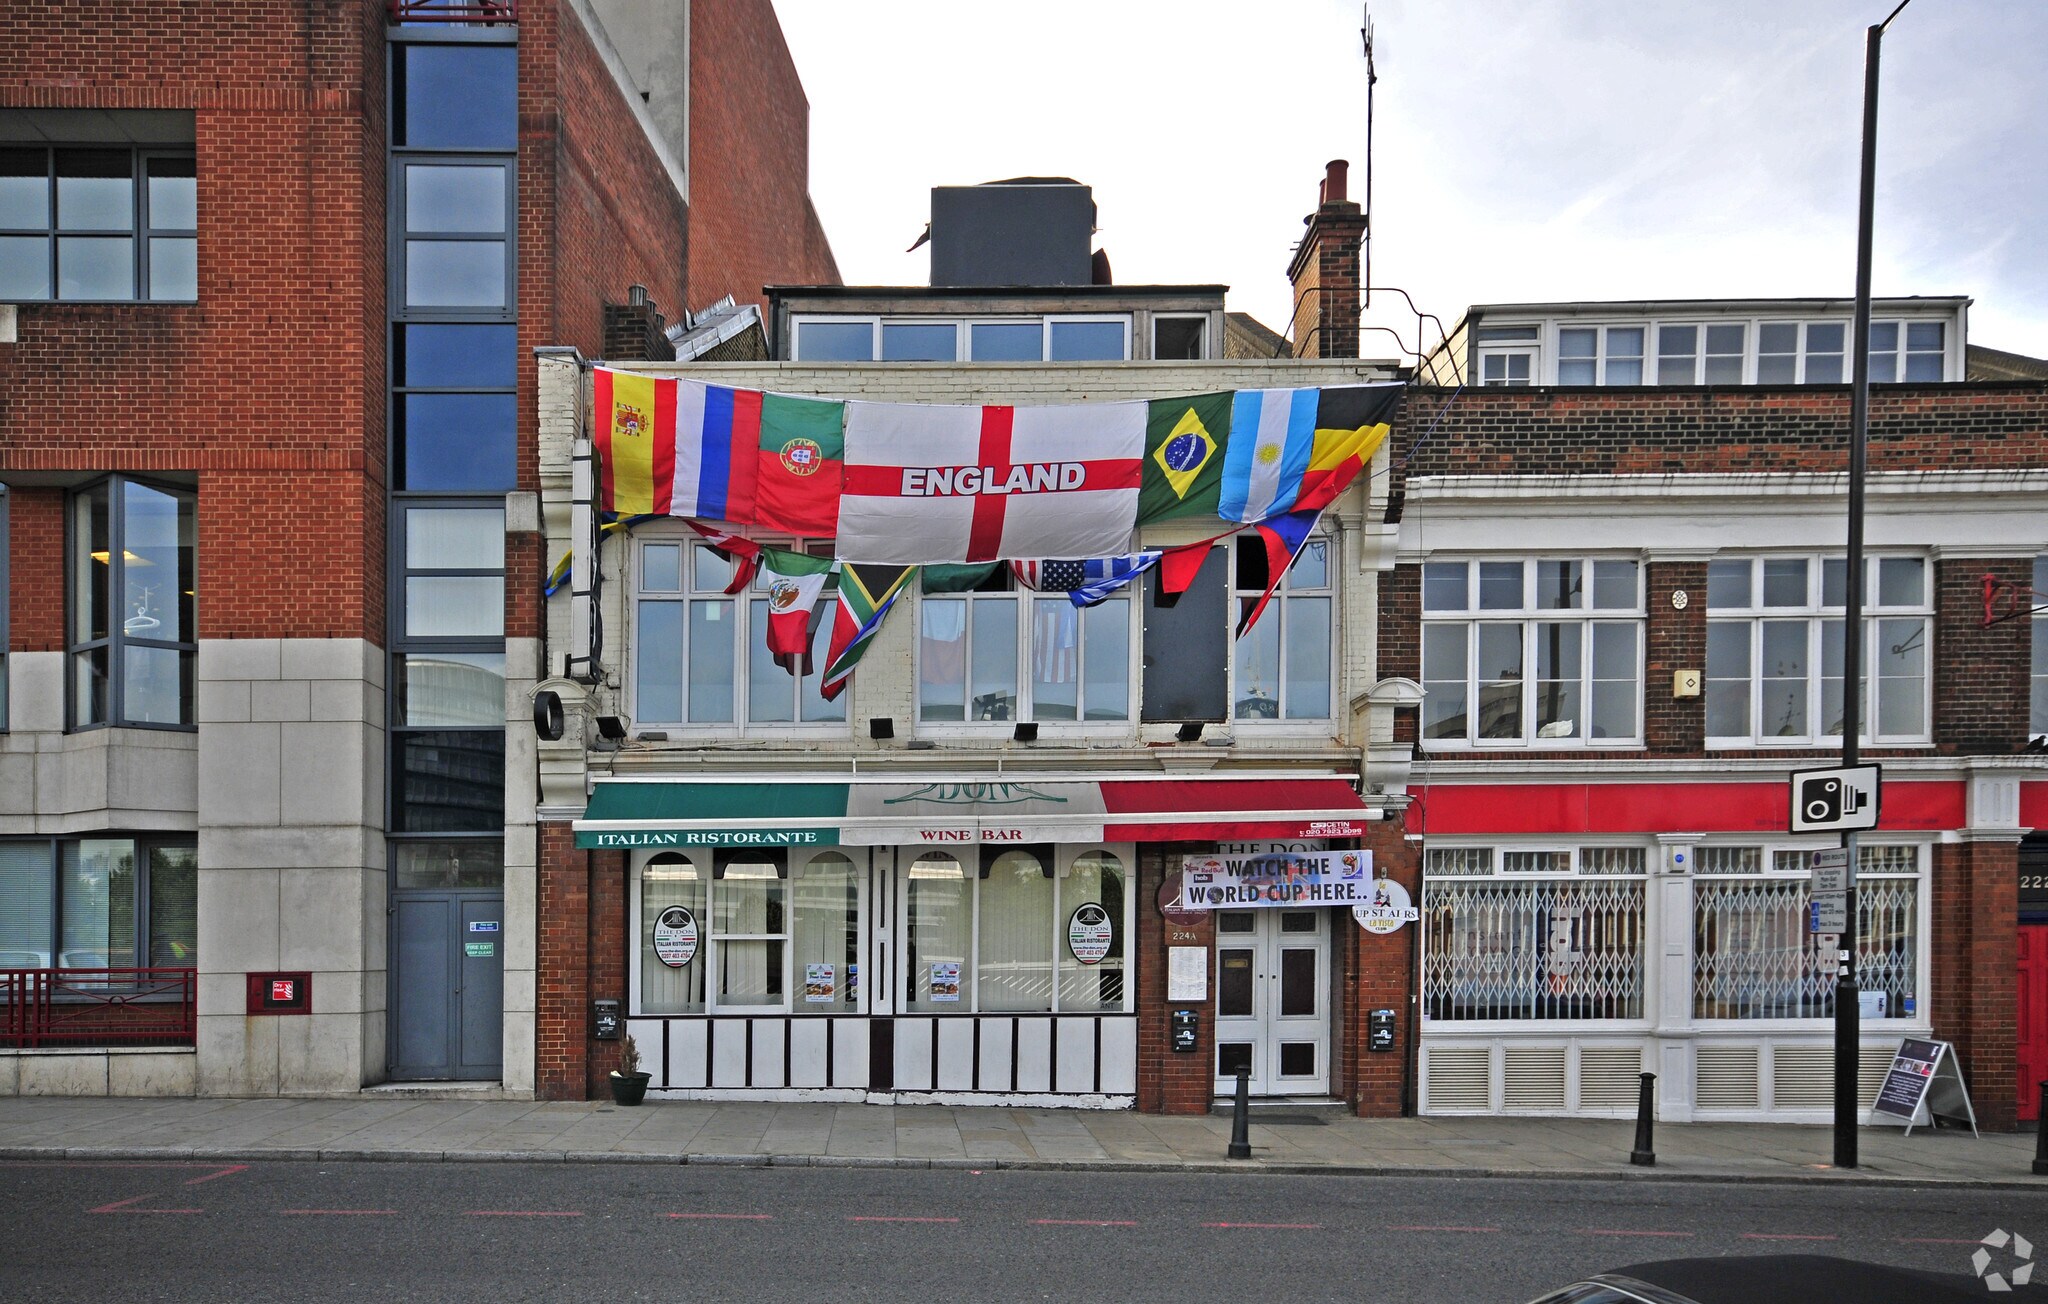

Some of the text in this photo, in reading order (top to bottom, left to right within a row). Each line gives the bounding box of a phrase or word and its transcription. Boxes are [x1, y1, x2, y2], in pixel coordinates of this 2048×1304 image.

[900, 461, 1086, 497] ENGLAND
[597, 832, 817, 846] ITALIAN RISTORANTE
[920, 829, 1022, 841] WINE BAR
[1226, 859, 1288, 877] WATCH
[1294, 858, 1330, 875] THE
[1267, 884, 1304, 902] CUP
[1173, 932, 1197, 940] 224A
